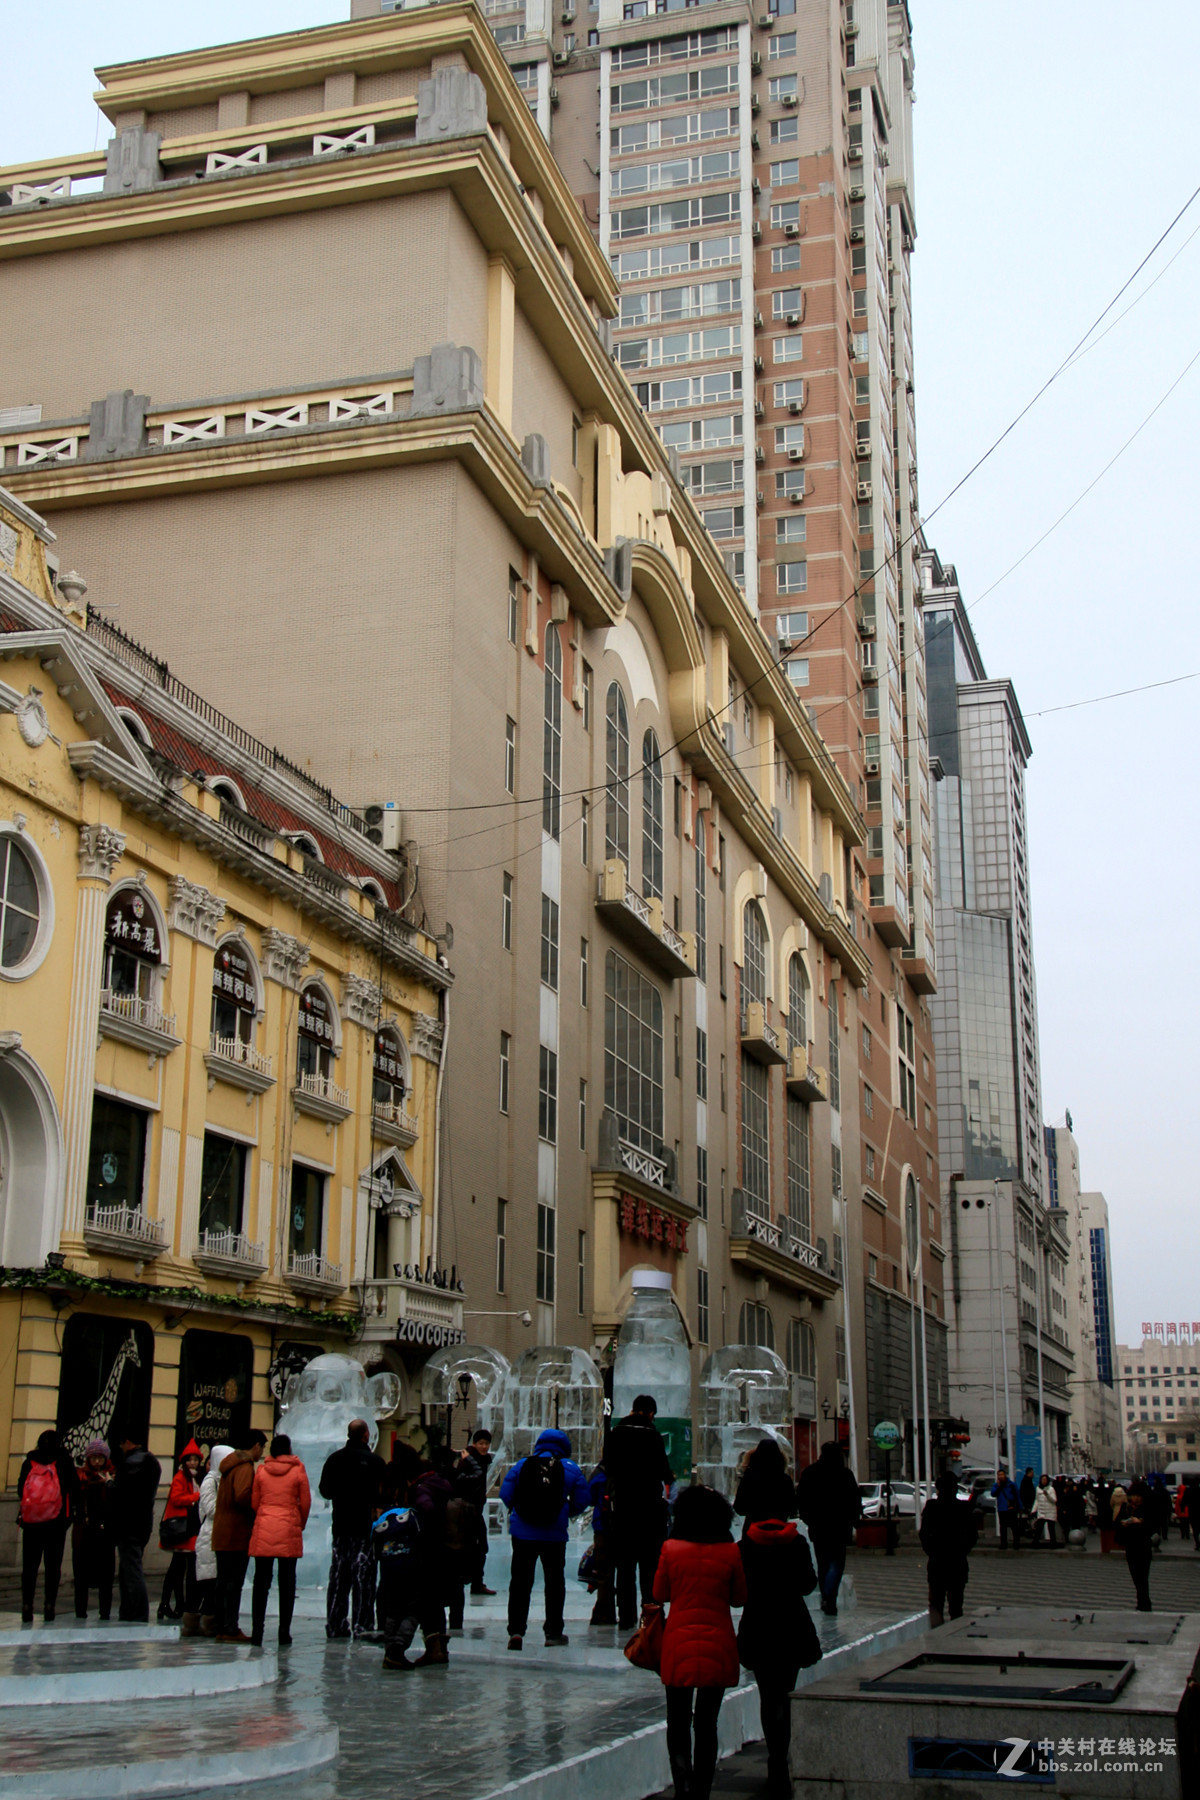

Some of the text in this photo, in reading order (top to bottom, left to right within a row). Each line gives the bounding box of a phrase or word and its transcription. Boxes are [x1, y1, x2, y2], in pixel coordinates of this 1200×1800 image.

[398, 1318, 467, 1348] ZOO COFFEE
[193, 1383, 224, 1399] WAFFLE
[205, 1402, 231, 1420] BREAD
